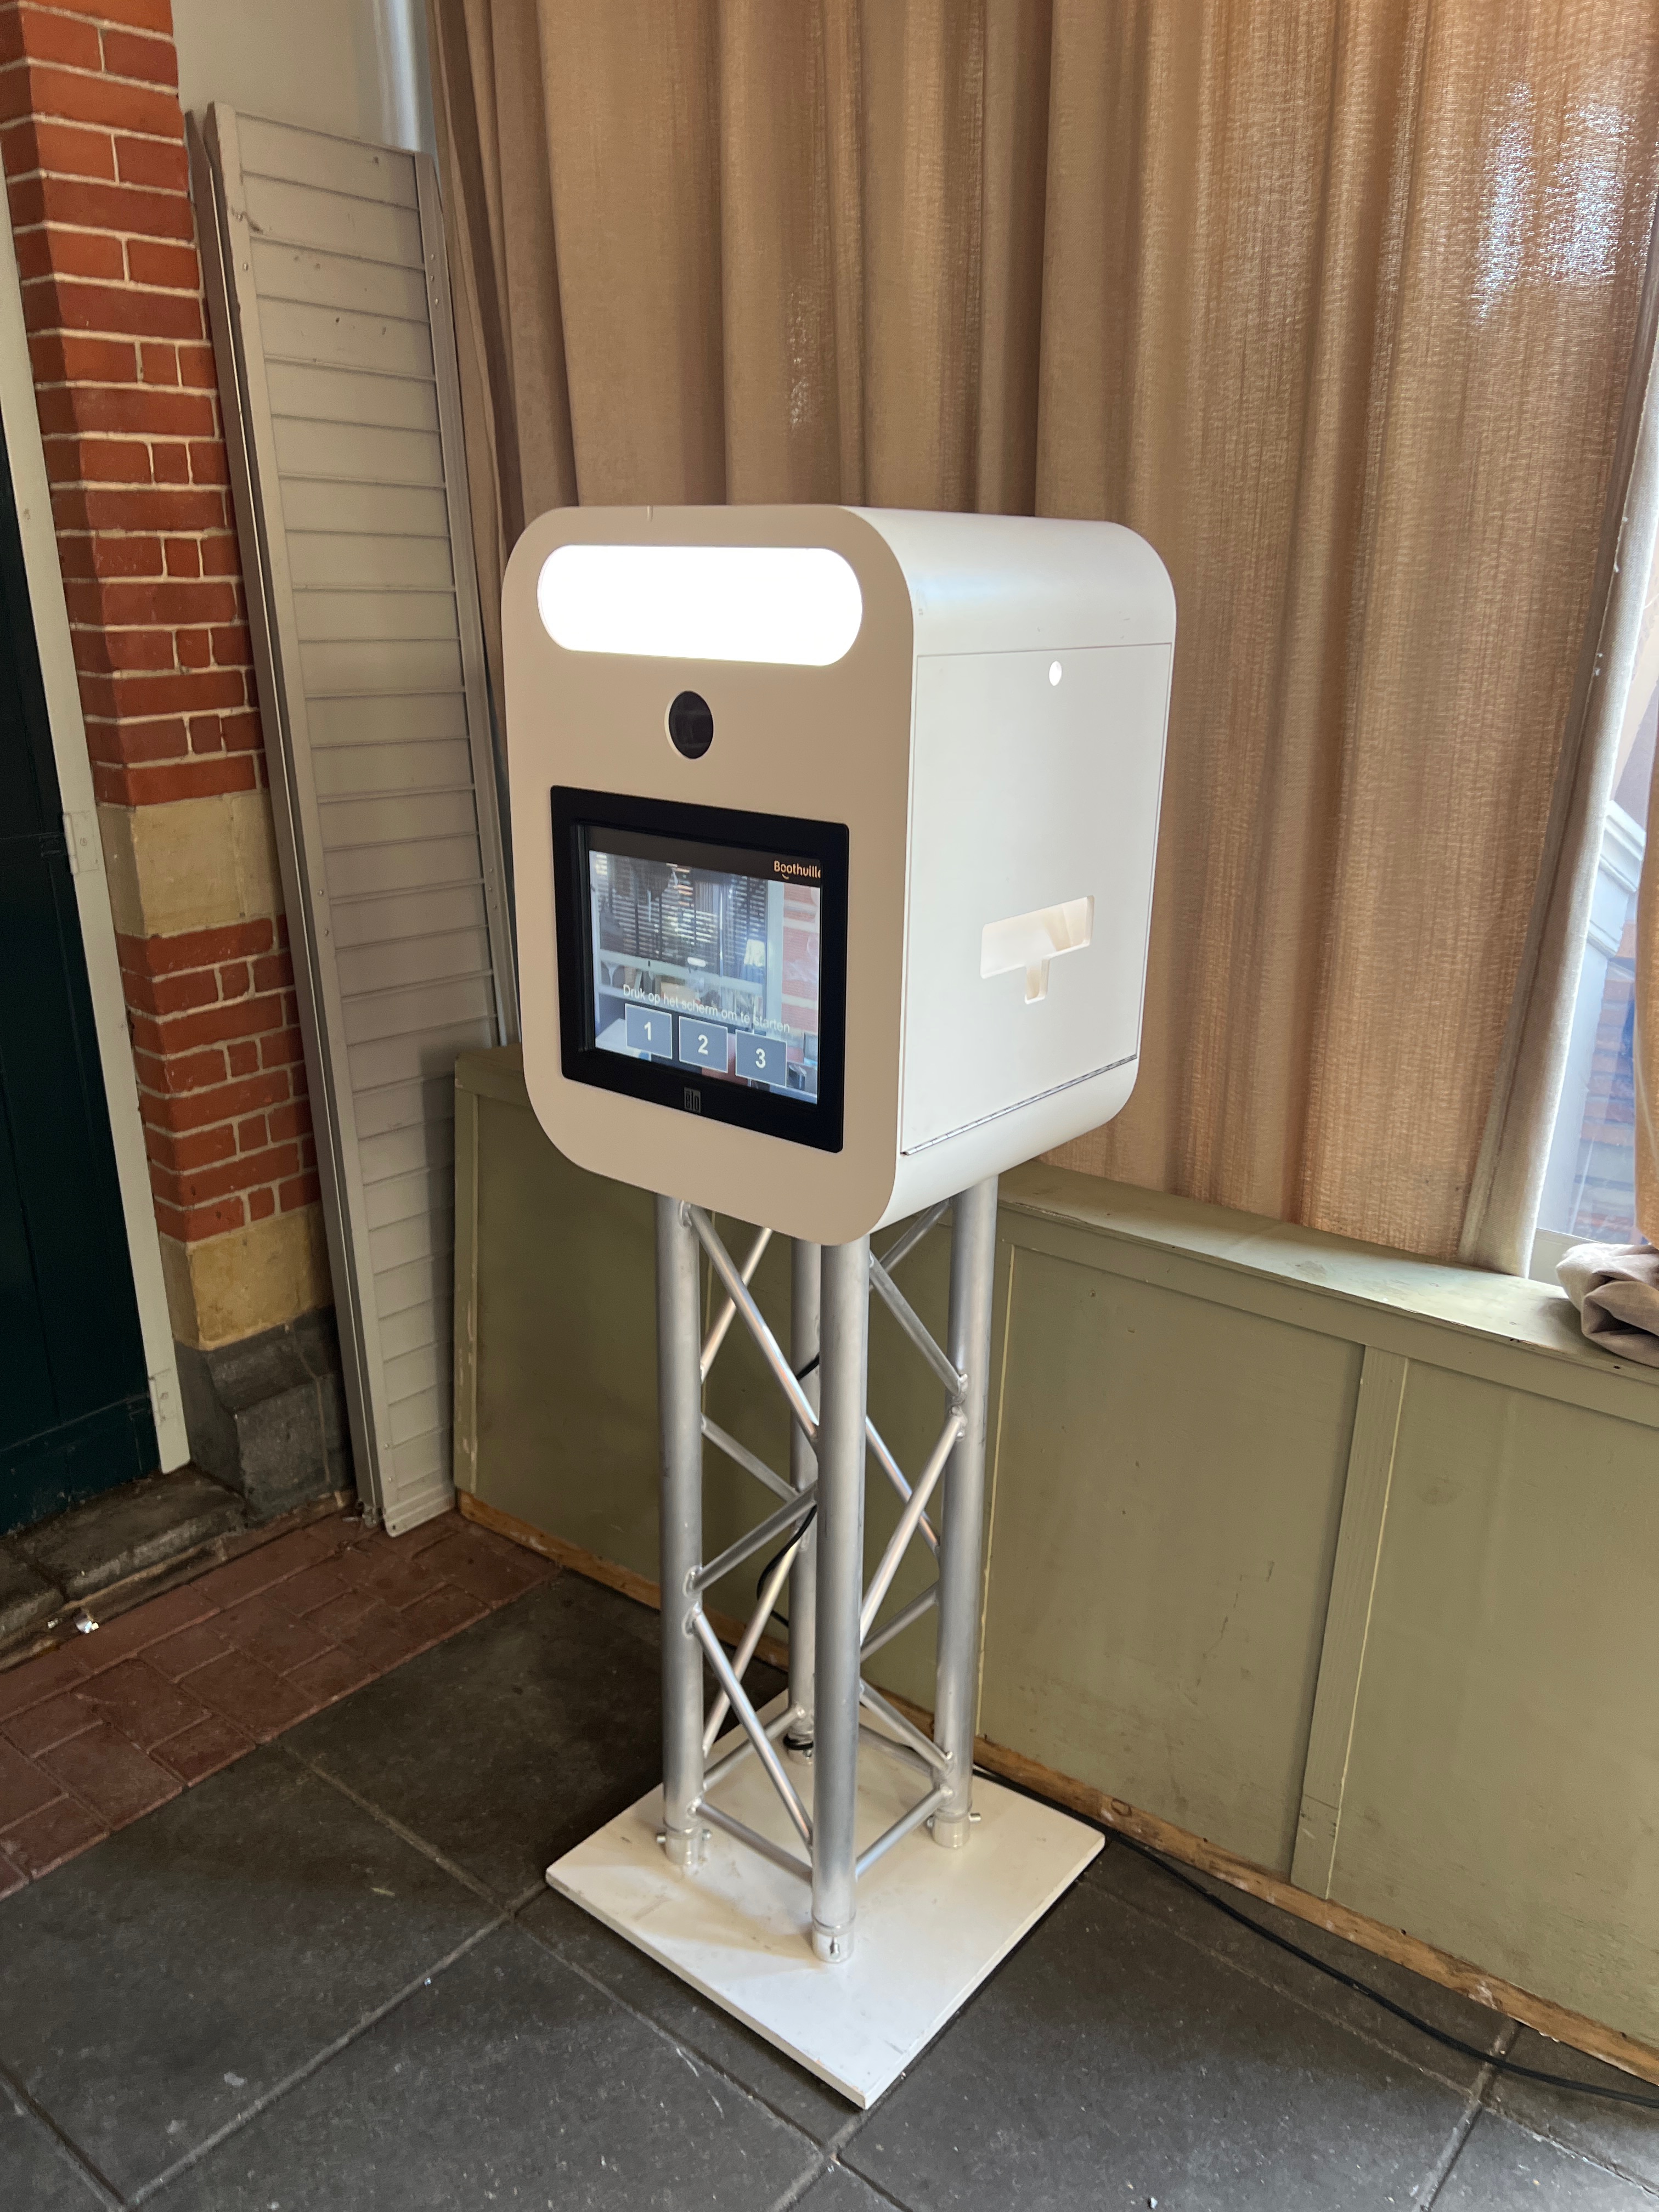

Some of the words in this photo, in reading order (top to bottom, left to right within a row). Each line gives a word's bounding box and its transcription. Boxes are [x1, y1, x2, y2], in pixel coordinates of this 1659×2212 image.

[623, 984, 645, 1000] Druk
[648, 992, 660, 1006] op
[663, 992, 679, 1008] het
[682, 1000, 718, 1017] scherm
[721, 1009, 737, 1021] om
[740, 1011, 751, 1024] te
[753, 1015, 790, 1033] starten
[644, 1022, 651, 1041] 1
[698, 1034, 708, 1056] 2
[755, 1048, 766, 1069] 3
